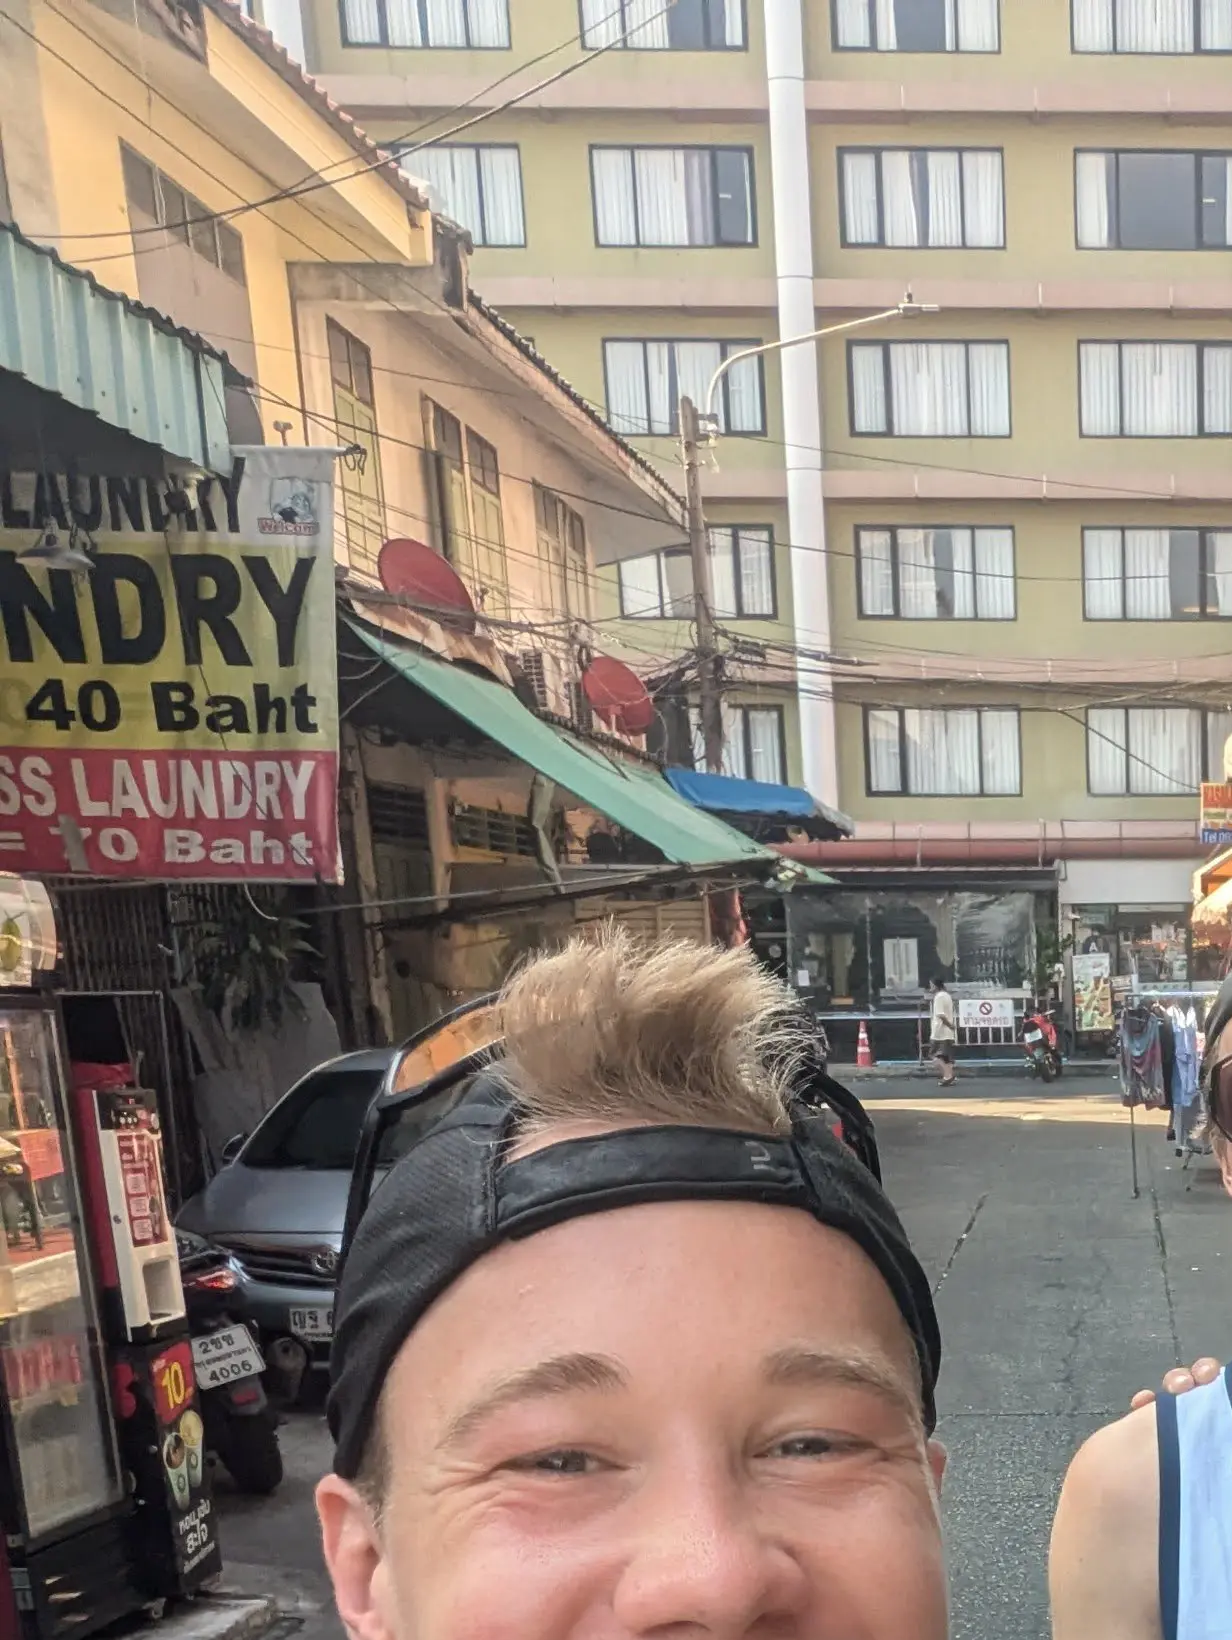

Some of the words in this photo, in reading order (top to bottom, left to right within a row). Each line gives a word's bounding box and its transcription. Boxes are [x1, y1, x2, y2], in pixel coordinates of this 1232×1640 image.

[0, 552, 316, 667] NDRY
[25, 678, 119, 732] 40
[151, 681, 318, 734] Baht
[71, 758, 316, 820] LAUNDRY
[163, 829, 313, 866] Baht
[162, 1361, 185, 1409] 10
[209, 1360, 252, 1381] 4006
